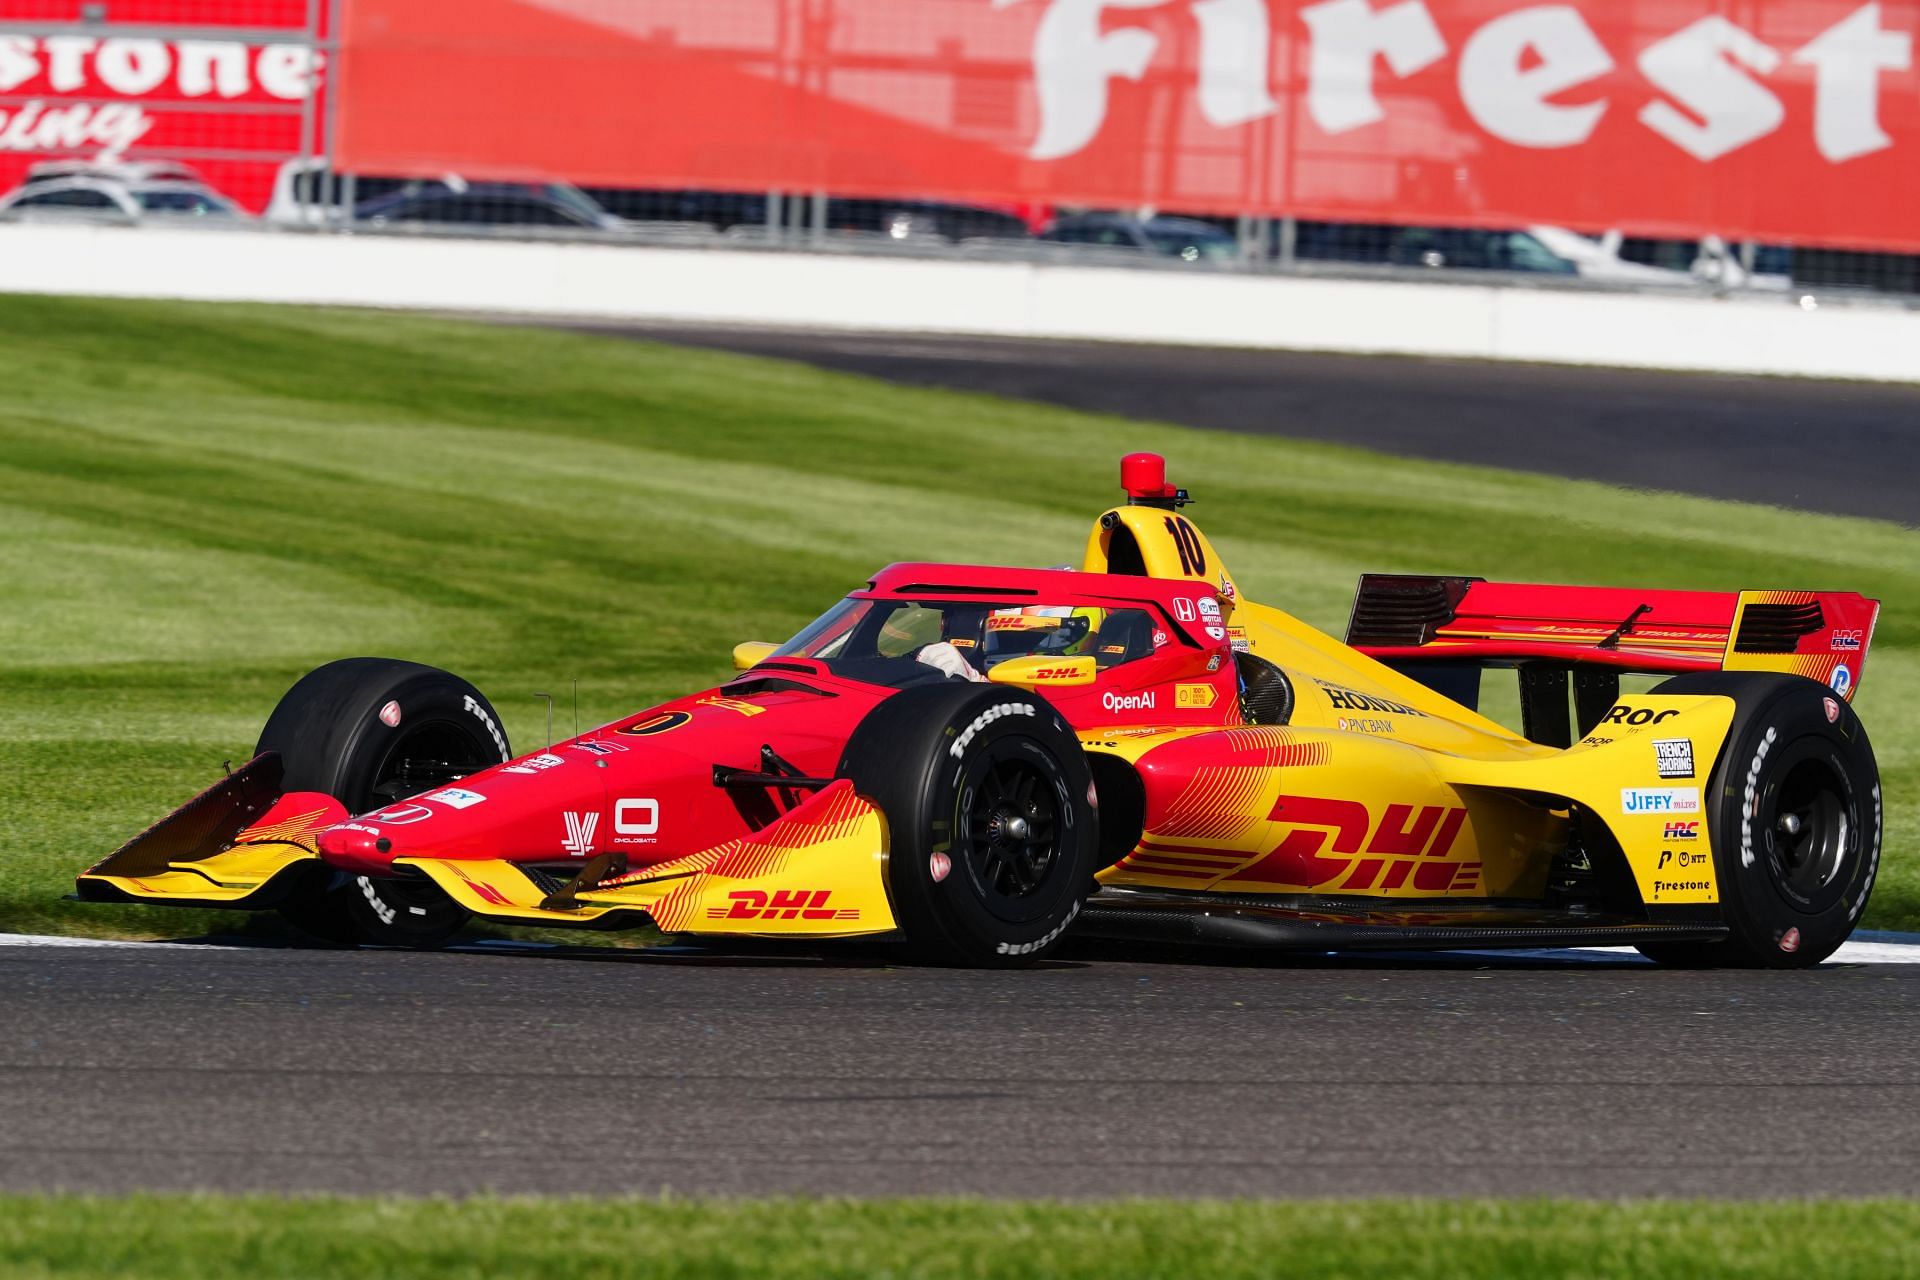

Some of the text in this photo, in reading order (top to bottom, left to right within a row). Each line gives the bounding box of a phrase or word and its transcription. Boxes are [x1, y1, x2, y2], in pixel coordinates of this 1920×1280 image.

[0, 100, 154, 168] ing
[1164, 516, 1206, 577] 10
[988, 617, 1026, 629] DHL
[1831, 629, 1863, 646] HRC
[1036, 667, 1080, 679] DHL
[1103, 692, 1155, 713] OpenAI
[1322, 687, 1429, 717] HONDA
[949, 702, 1036, 759] Firestone
[1652, 742, 1691, 757] TRENCH
[1657, 757, 1692, 771] SHORING
[1741, 726, 1777, 869] Firestone
[1664, 822, 1700, 838] HRC
[1221, 795, 1468, 890] DHL
[1691, 854, 1707, 863] NTT
[1654, 881, 1710, 893] Firestone
[726, 890, 838, 919] DHL
